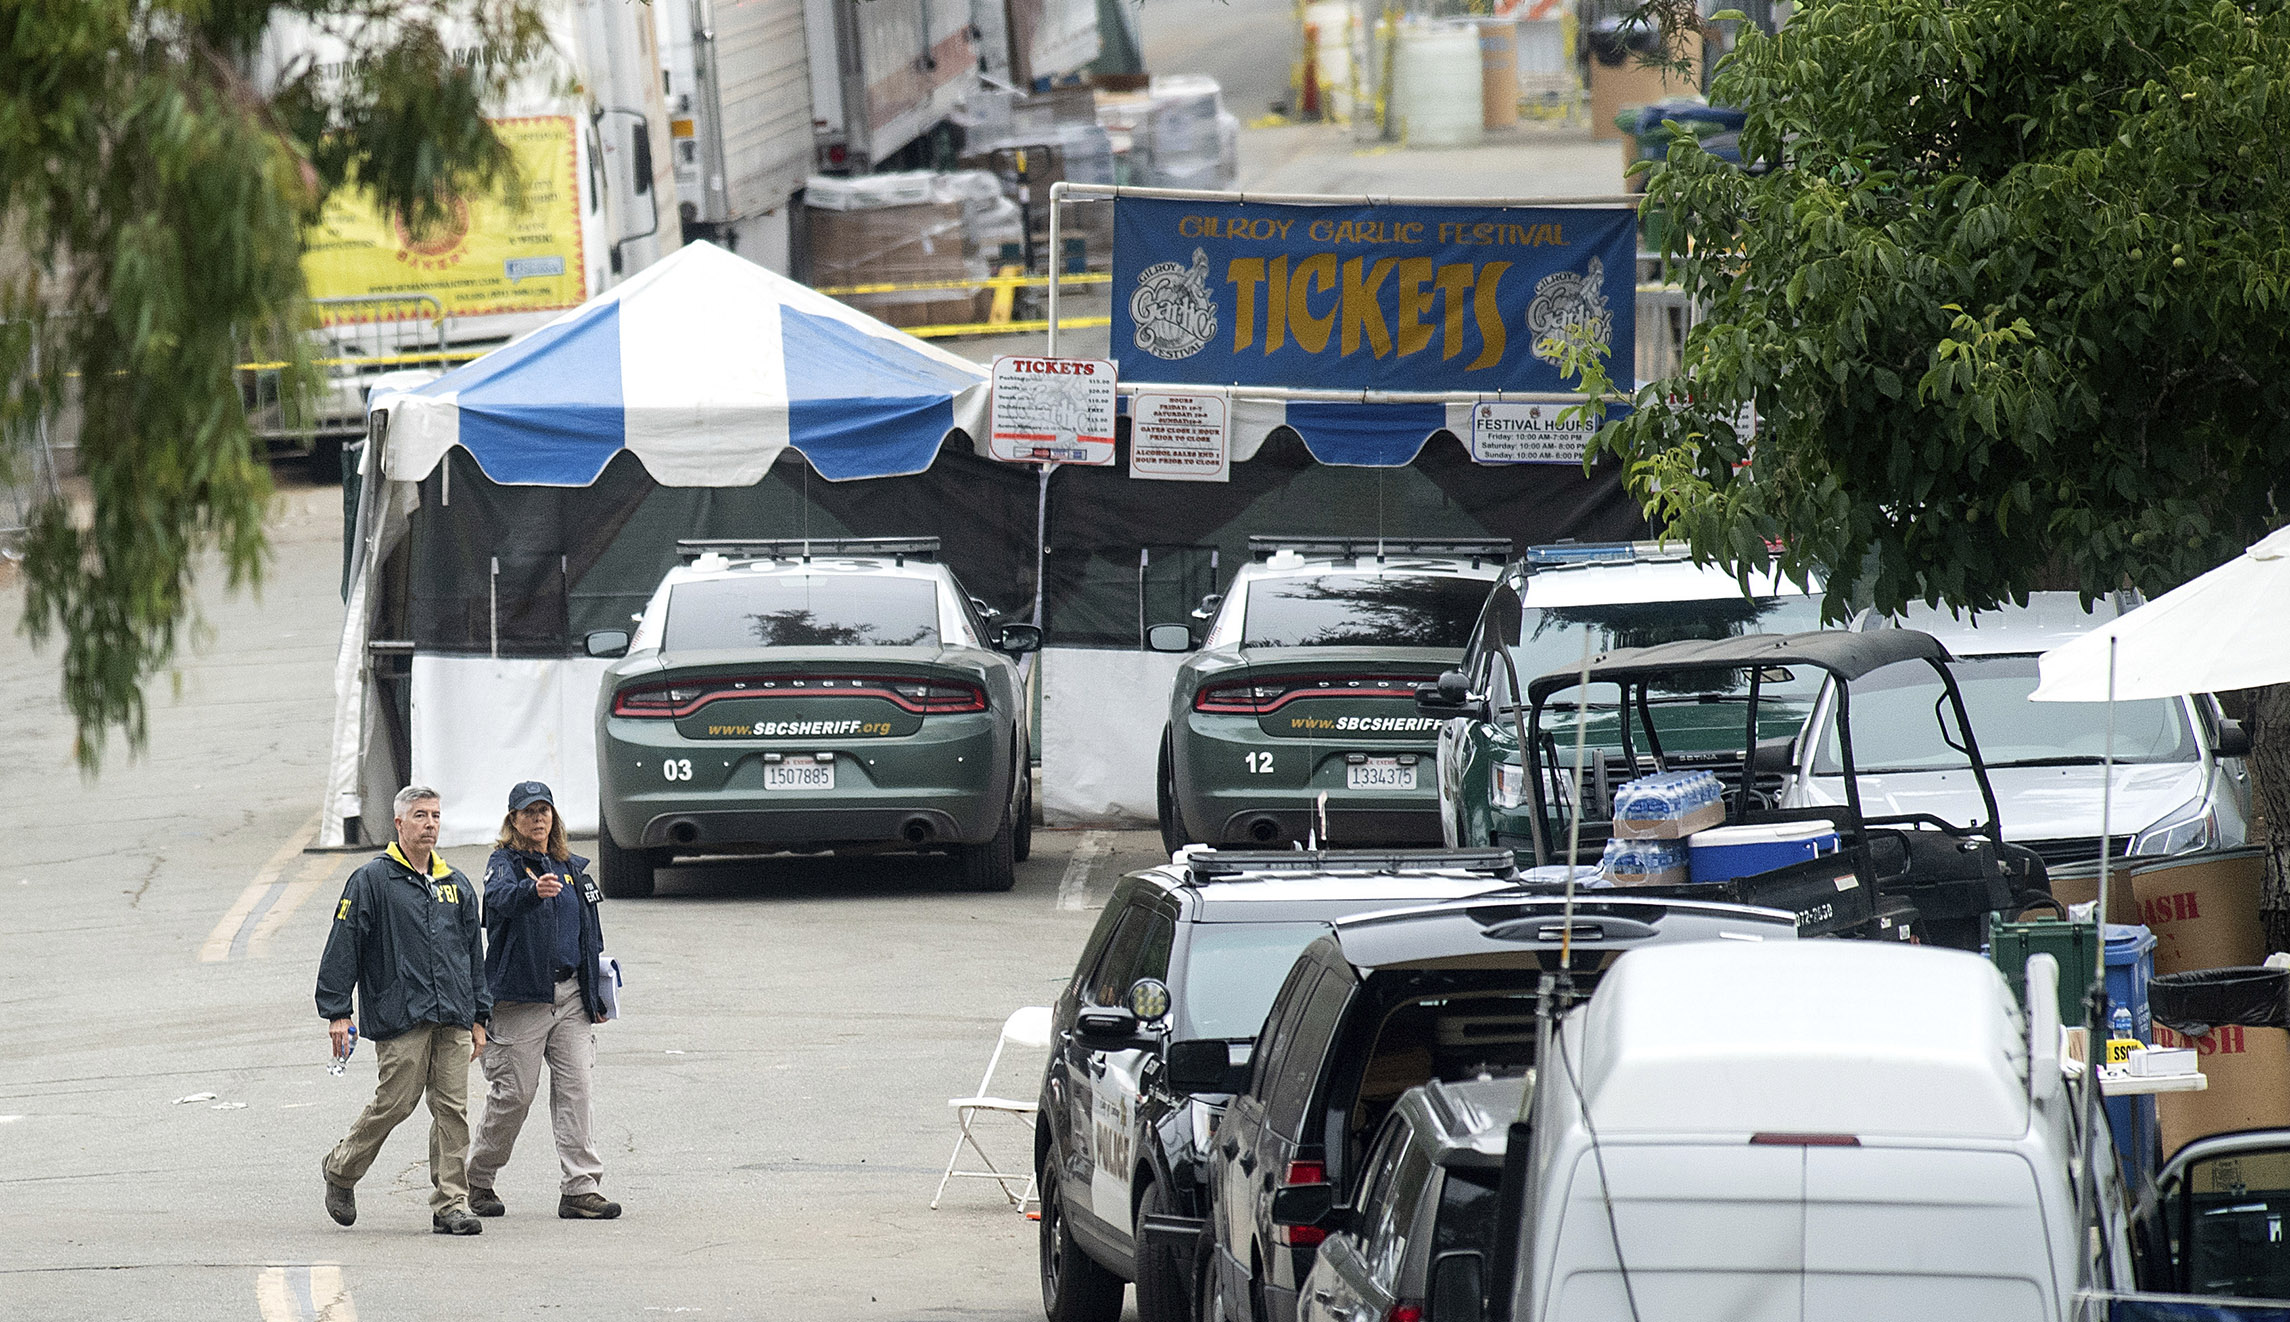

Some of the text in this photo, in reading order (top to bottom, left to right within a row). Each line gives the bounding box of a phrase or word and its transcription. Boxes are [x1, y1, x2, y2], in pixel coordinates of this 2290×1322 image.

[1179, 215, 1571, 248] GILROY GARLIC FESTIVAL
[1138, 263, 1177, 283] GILROY
[1535, 271, 1573, 293] GILROY
[1226, 253, 1514, 372] TICKETS
[1151, 342, 1202, 359] FESTIVAL
[1012, 360, 1095, 376] TICKETS
[1477, 419, 1541, 430] FESTIVAL
[1482, 442, 1518, 450] Saturday:
[1520, 442, 1540, 450] 10:00
[1488, 433, 1514, 441] Friday:
[1485, 452, 1515, 460] Sunday:
[708, 719, 892, 737] www.SBCSHERIFF.org
[663, 759, 693, 781] 03
[1245, 752, 1275, 773] 12
[770, 767, 829, 784] 1507885
[1352, 767, 1412, 785] 1334375
[437, 884, 460, 904] FBI
[584, 890, 600, 903] ERT
